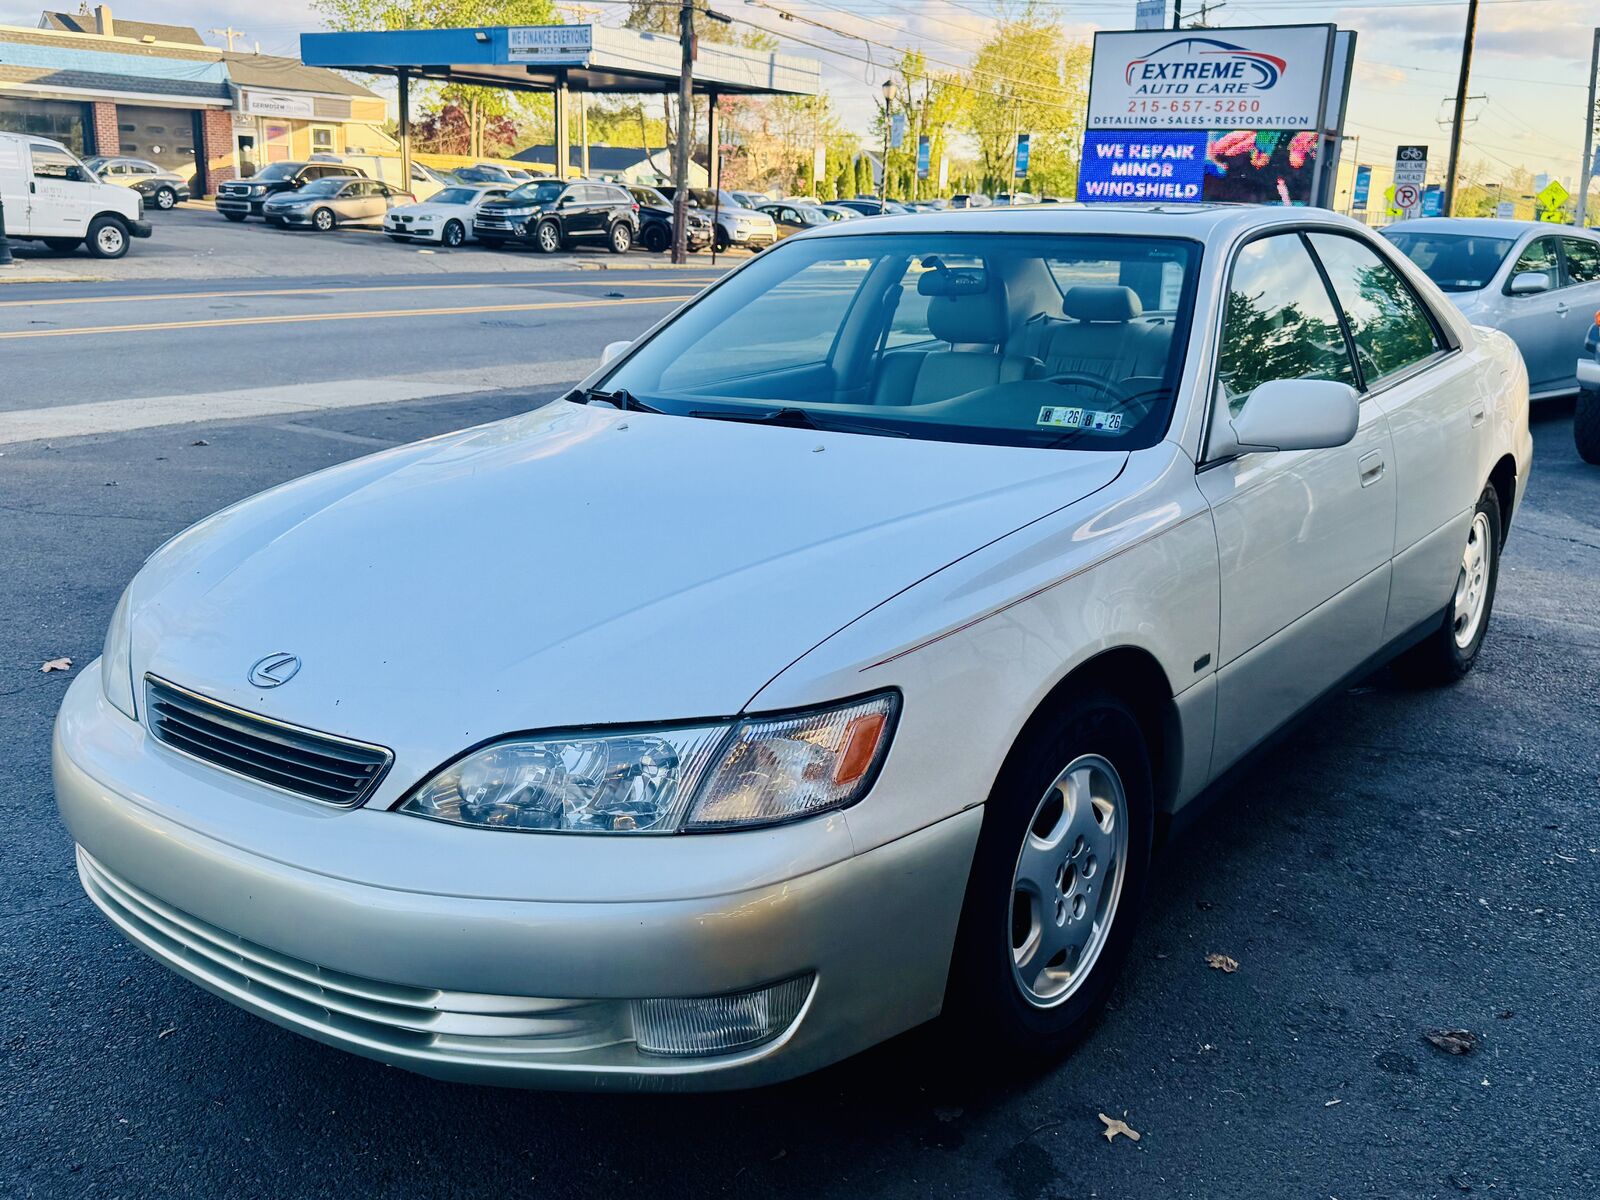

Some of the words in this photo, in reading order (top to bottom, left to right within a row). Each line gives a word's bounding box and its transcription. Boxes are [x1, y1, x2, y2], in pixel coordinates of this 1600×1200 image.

[512, 31, 521, 44] WE
[523, 31, 552, 44] FINANCE
[553, 29, 589, 44] EVERYONE
[1141, 61, 1247, 80] EXTREME
[1135, 83, 1189, 95] AUTO
[1196, 82, 1250, 95] CARE
[1128, 100, 1260, 113] 215-657-5260
[1094, 116, 1158, 125] DETAILING
[1167, 116, 1205, 125] SALES
[1215, 116, 1309, 125] RESTORATION
[1096, 143, 1124, 159] WE
[1129, 144, 1195, 160] REPAIR
[1111, 162, 1173, 177] MINOR
[1085, 181, 1198, 198] WINDSHIELD
[1043, 410, 1051, 422] 8
[1067, 410, 1079, 424] 26
[1084, 414, 1092, 426] 8
[1109, 414, 1120, 428] 26
